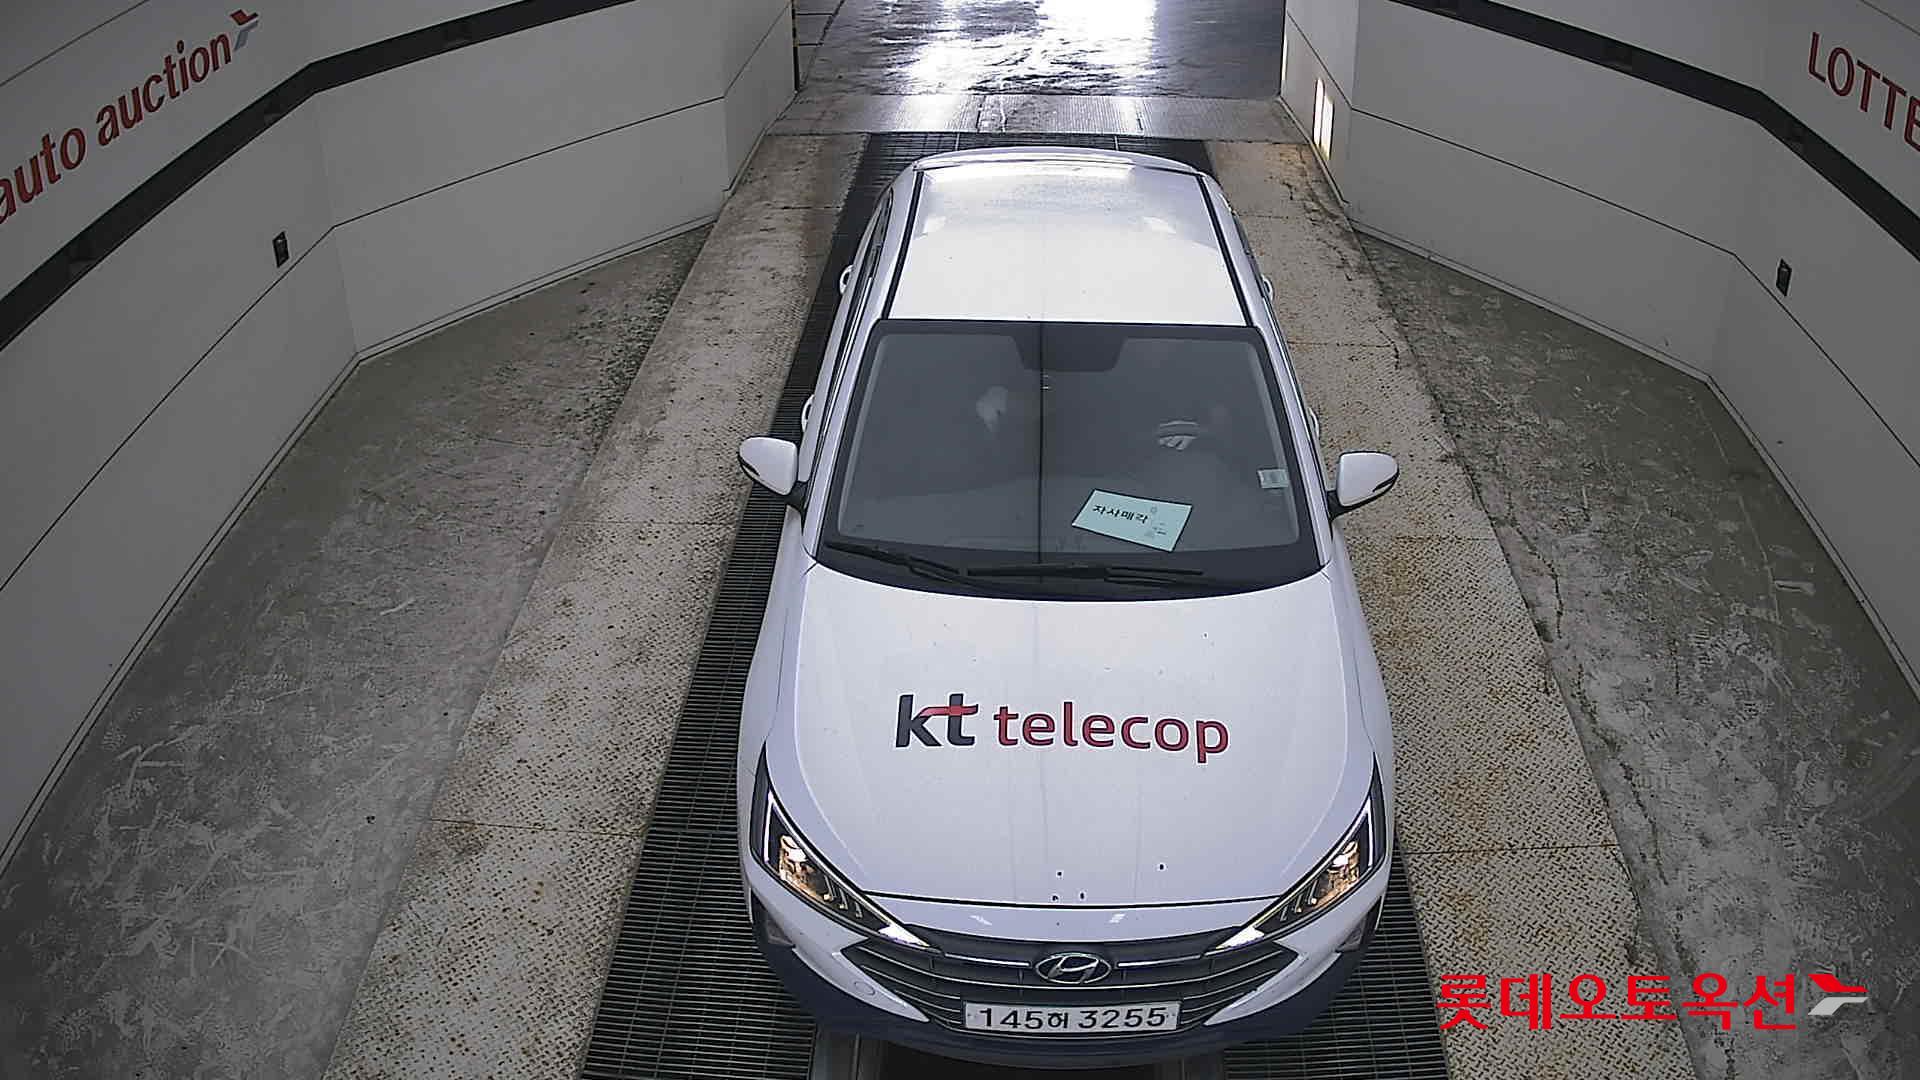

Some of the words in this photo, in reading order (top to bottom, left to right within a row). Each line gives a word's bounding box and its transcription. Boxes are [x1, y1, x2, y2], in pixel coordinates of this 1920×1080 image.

[0, 128, 87, 224] auto
[96, 34, 232, 147] auction
[895, 693, 979, 748] kt
[993, 701, 1229, 764] telecop
[979, 1007, 1069, 1030] 145허
[1078, 1007, 1167, 1029] 3255
